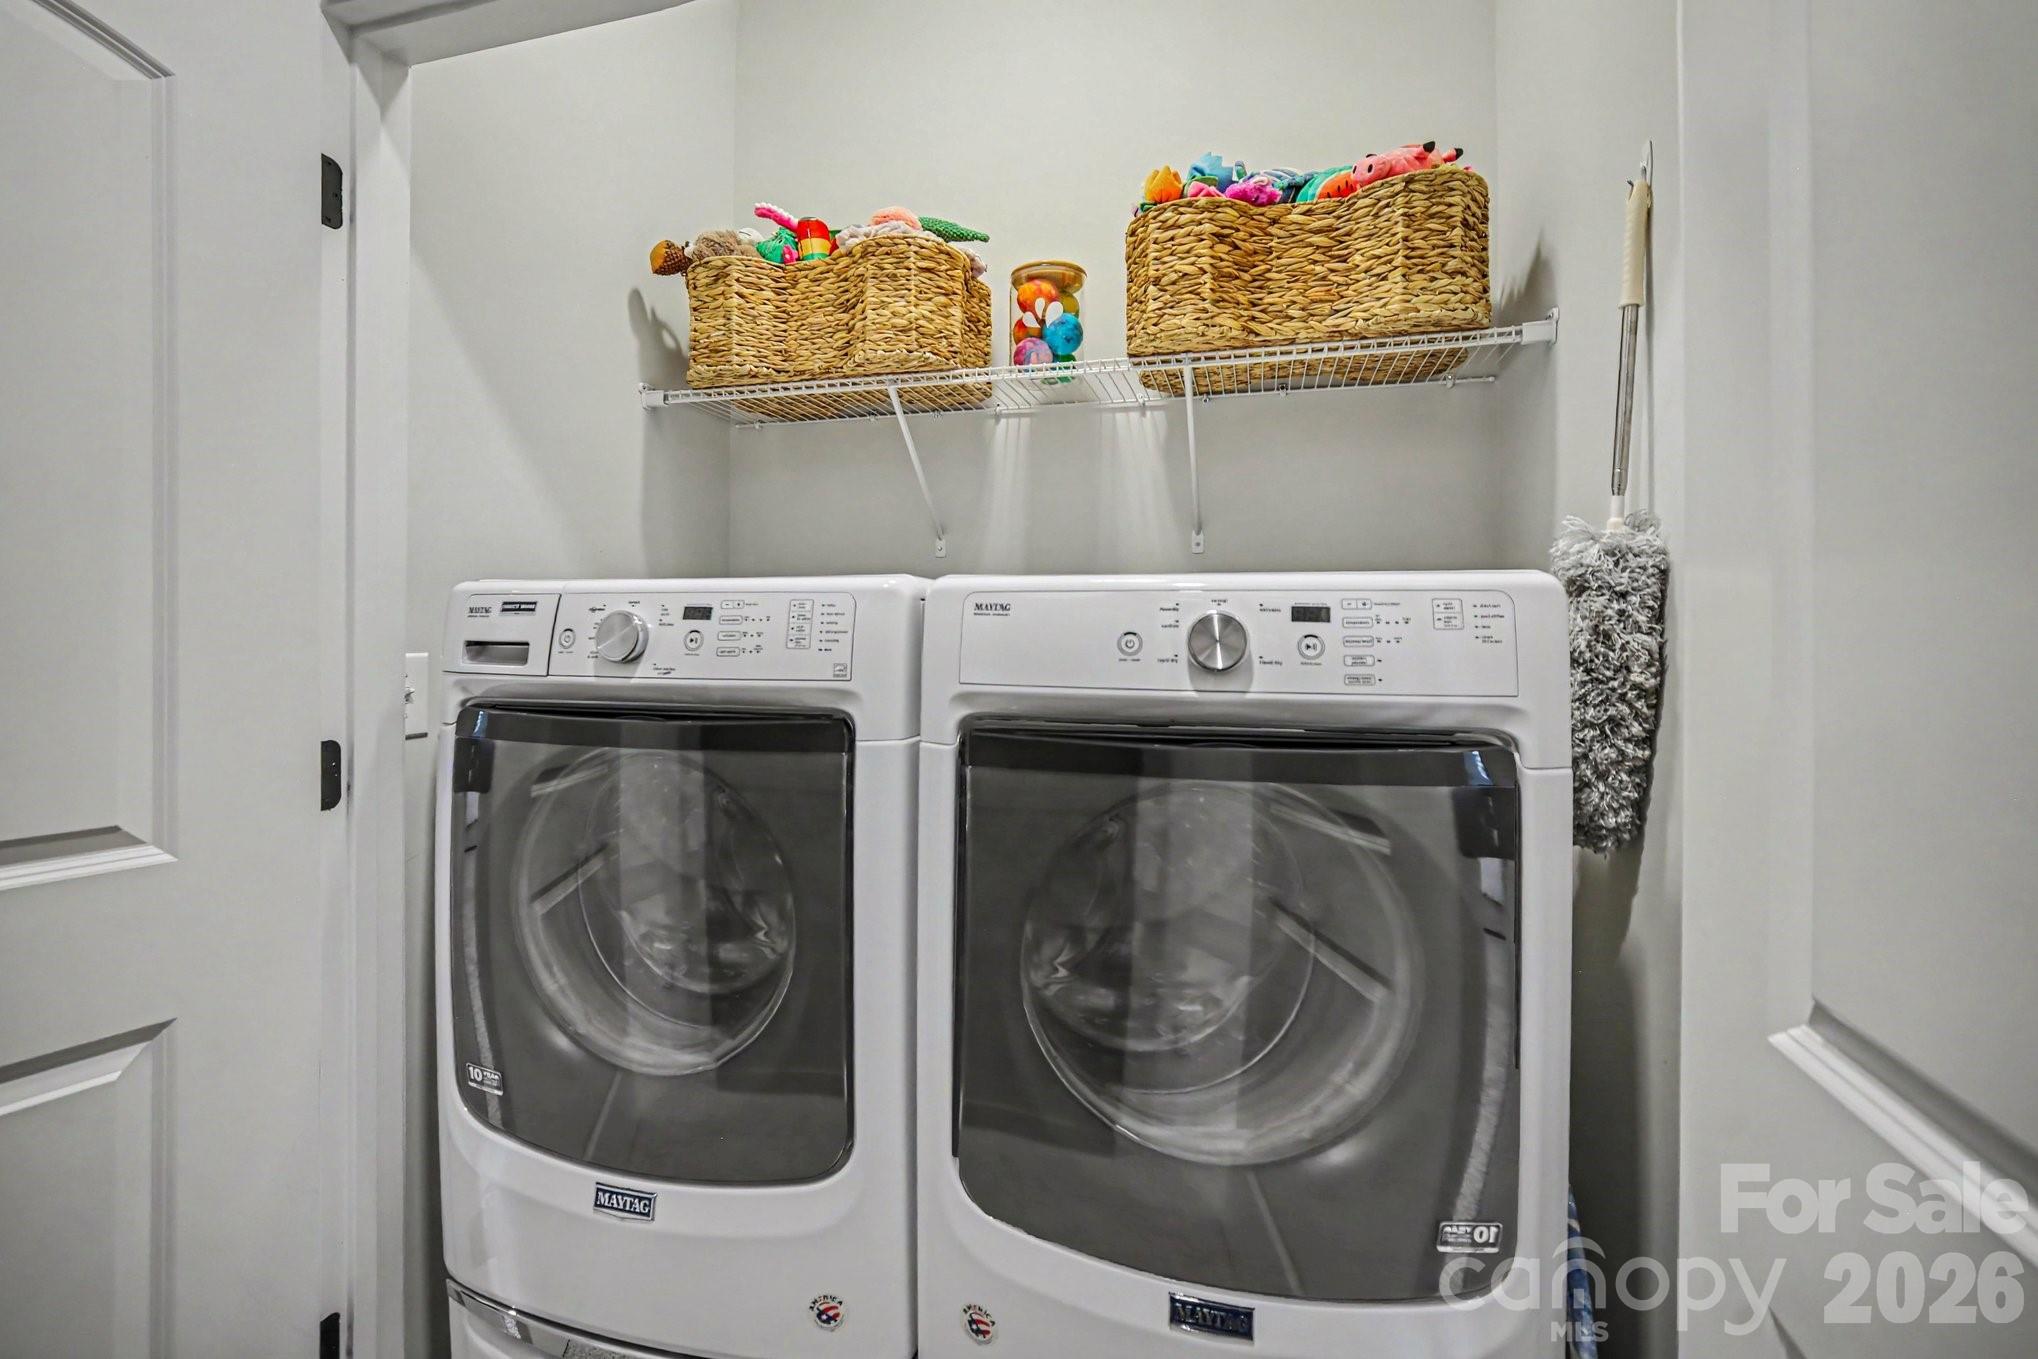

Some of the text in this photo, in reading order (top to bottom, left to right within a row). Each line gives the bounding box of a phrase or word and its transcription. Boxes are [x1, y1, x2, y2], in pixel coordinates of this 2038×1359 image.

[973, 602, 1011, 611] MAYTAG
[468, 1066, 483, 1081] 10
[596, 1191, 651, 1214] MAYTAG
